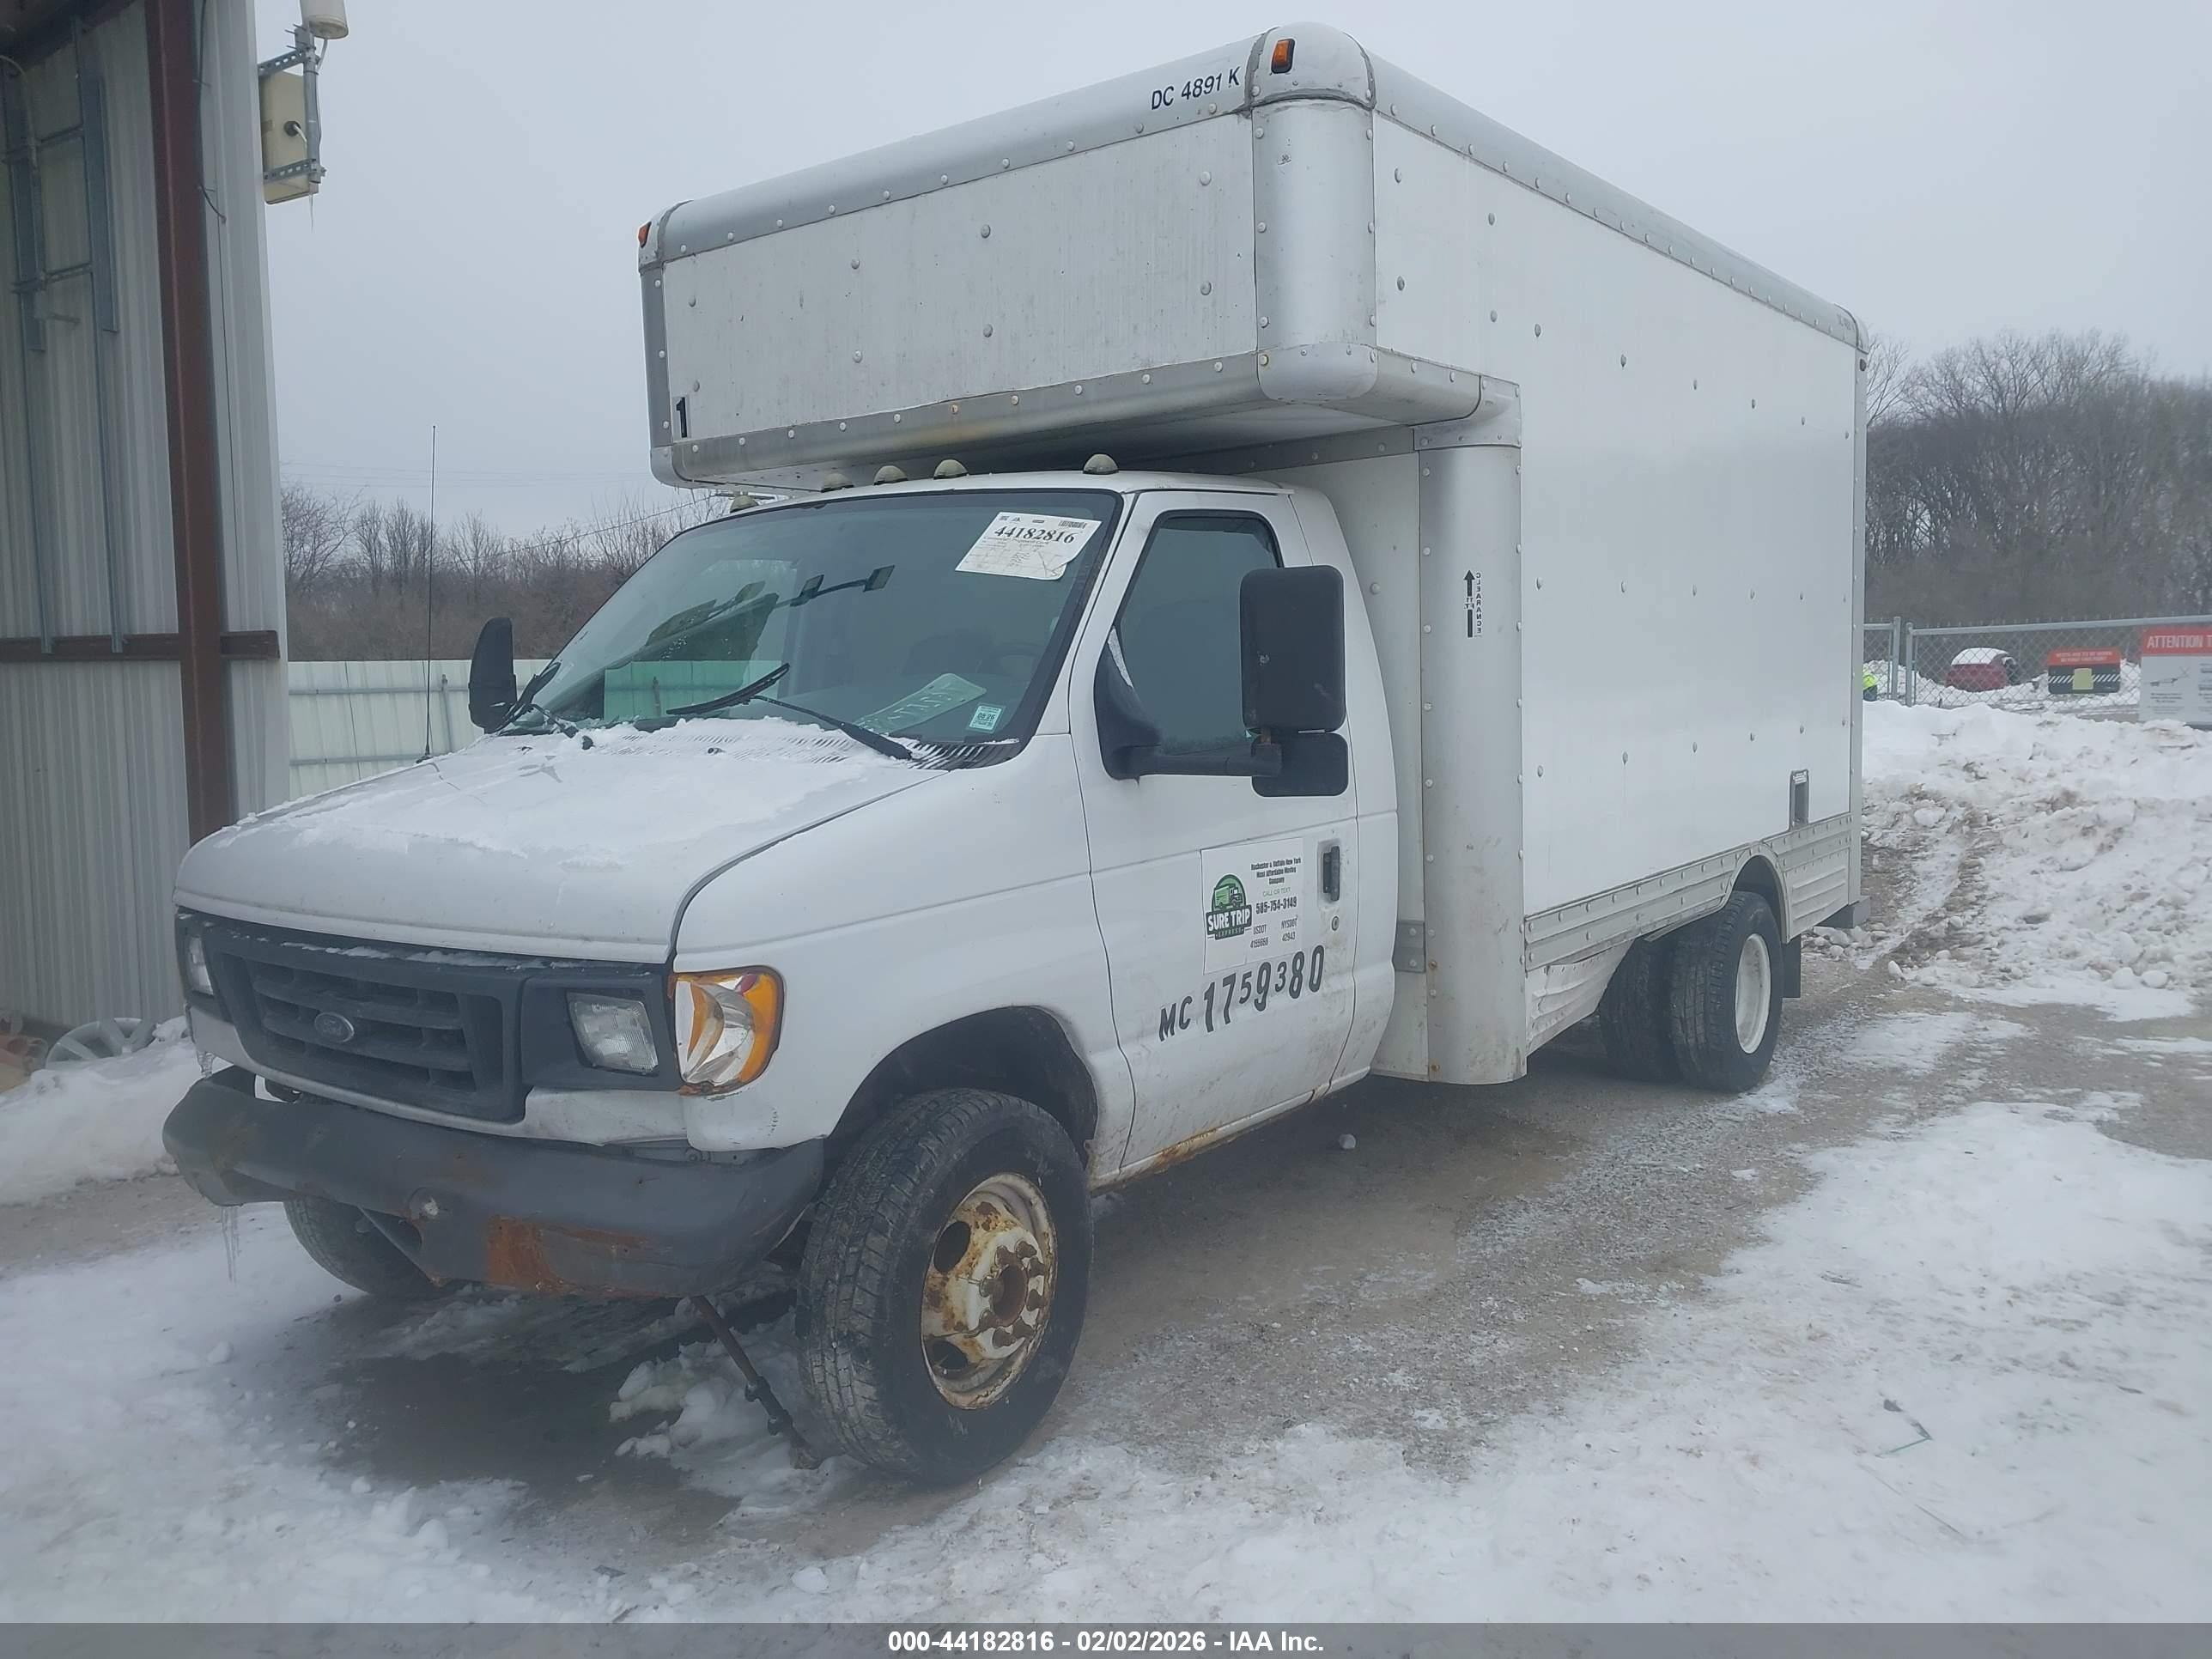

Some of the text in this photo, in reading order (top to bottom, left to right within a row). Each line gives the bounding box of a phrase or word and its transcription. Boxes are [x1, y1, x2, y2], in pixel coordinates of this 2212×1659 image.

[1152, 66, 1240, 110] DC 4891 K
[676, 397, 688, 438] 1
[994, 526, 1075, 544] 44182816
[2147, 635, 2204, 648] ATTENTION
[1207, 908, 1251, 932] SURE TRIP
[1253, 924, 1267, 934] USDOT
[1281, 918, 1297, 929] NYSDOT
[1218, 927, 1242, 938] EXPRESS
[1158, 945, 1325, 1042] MC 1759380
